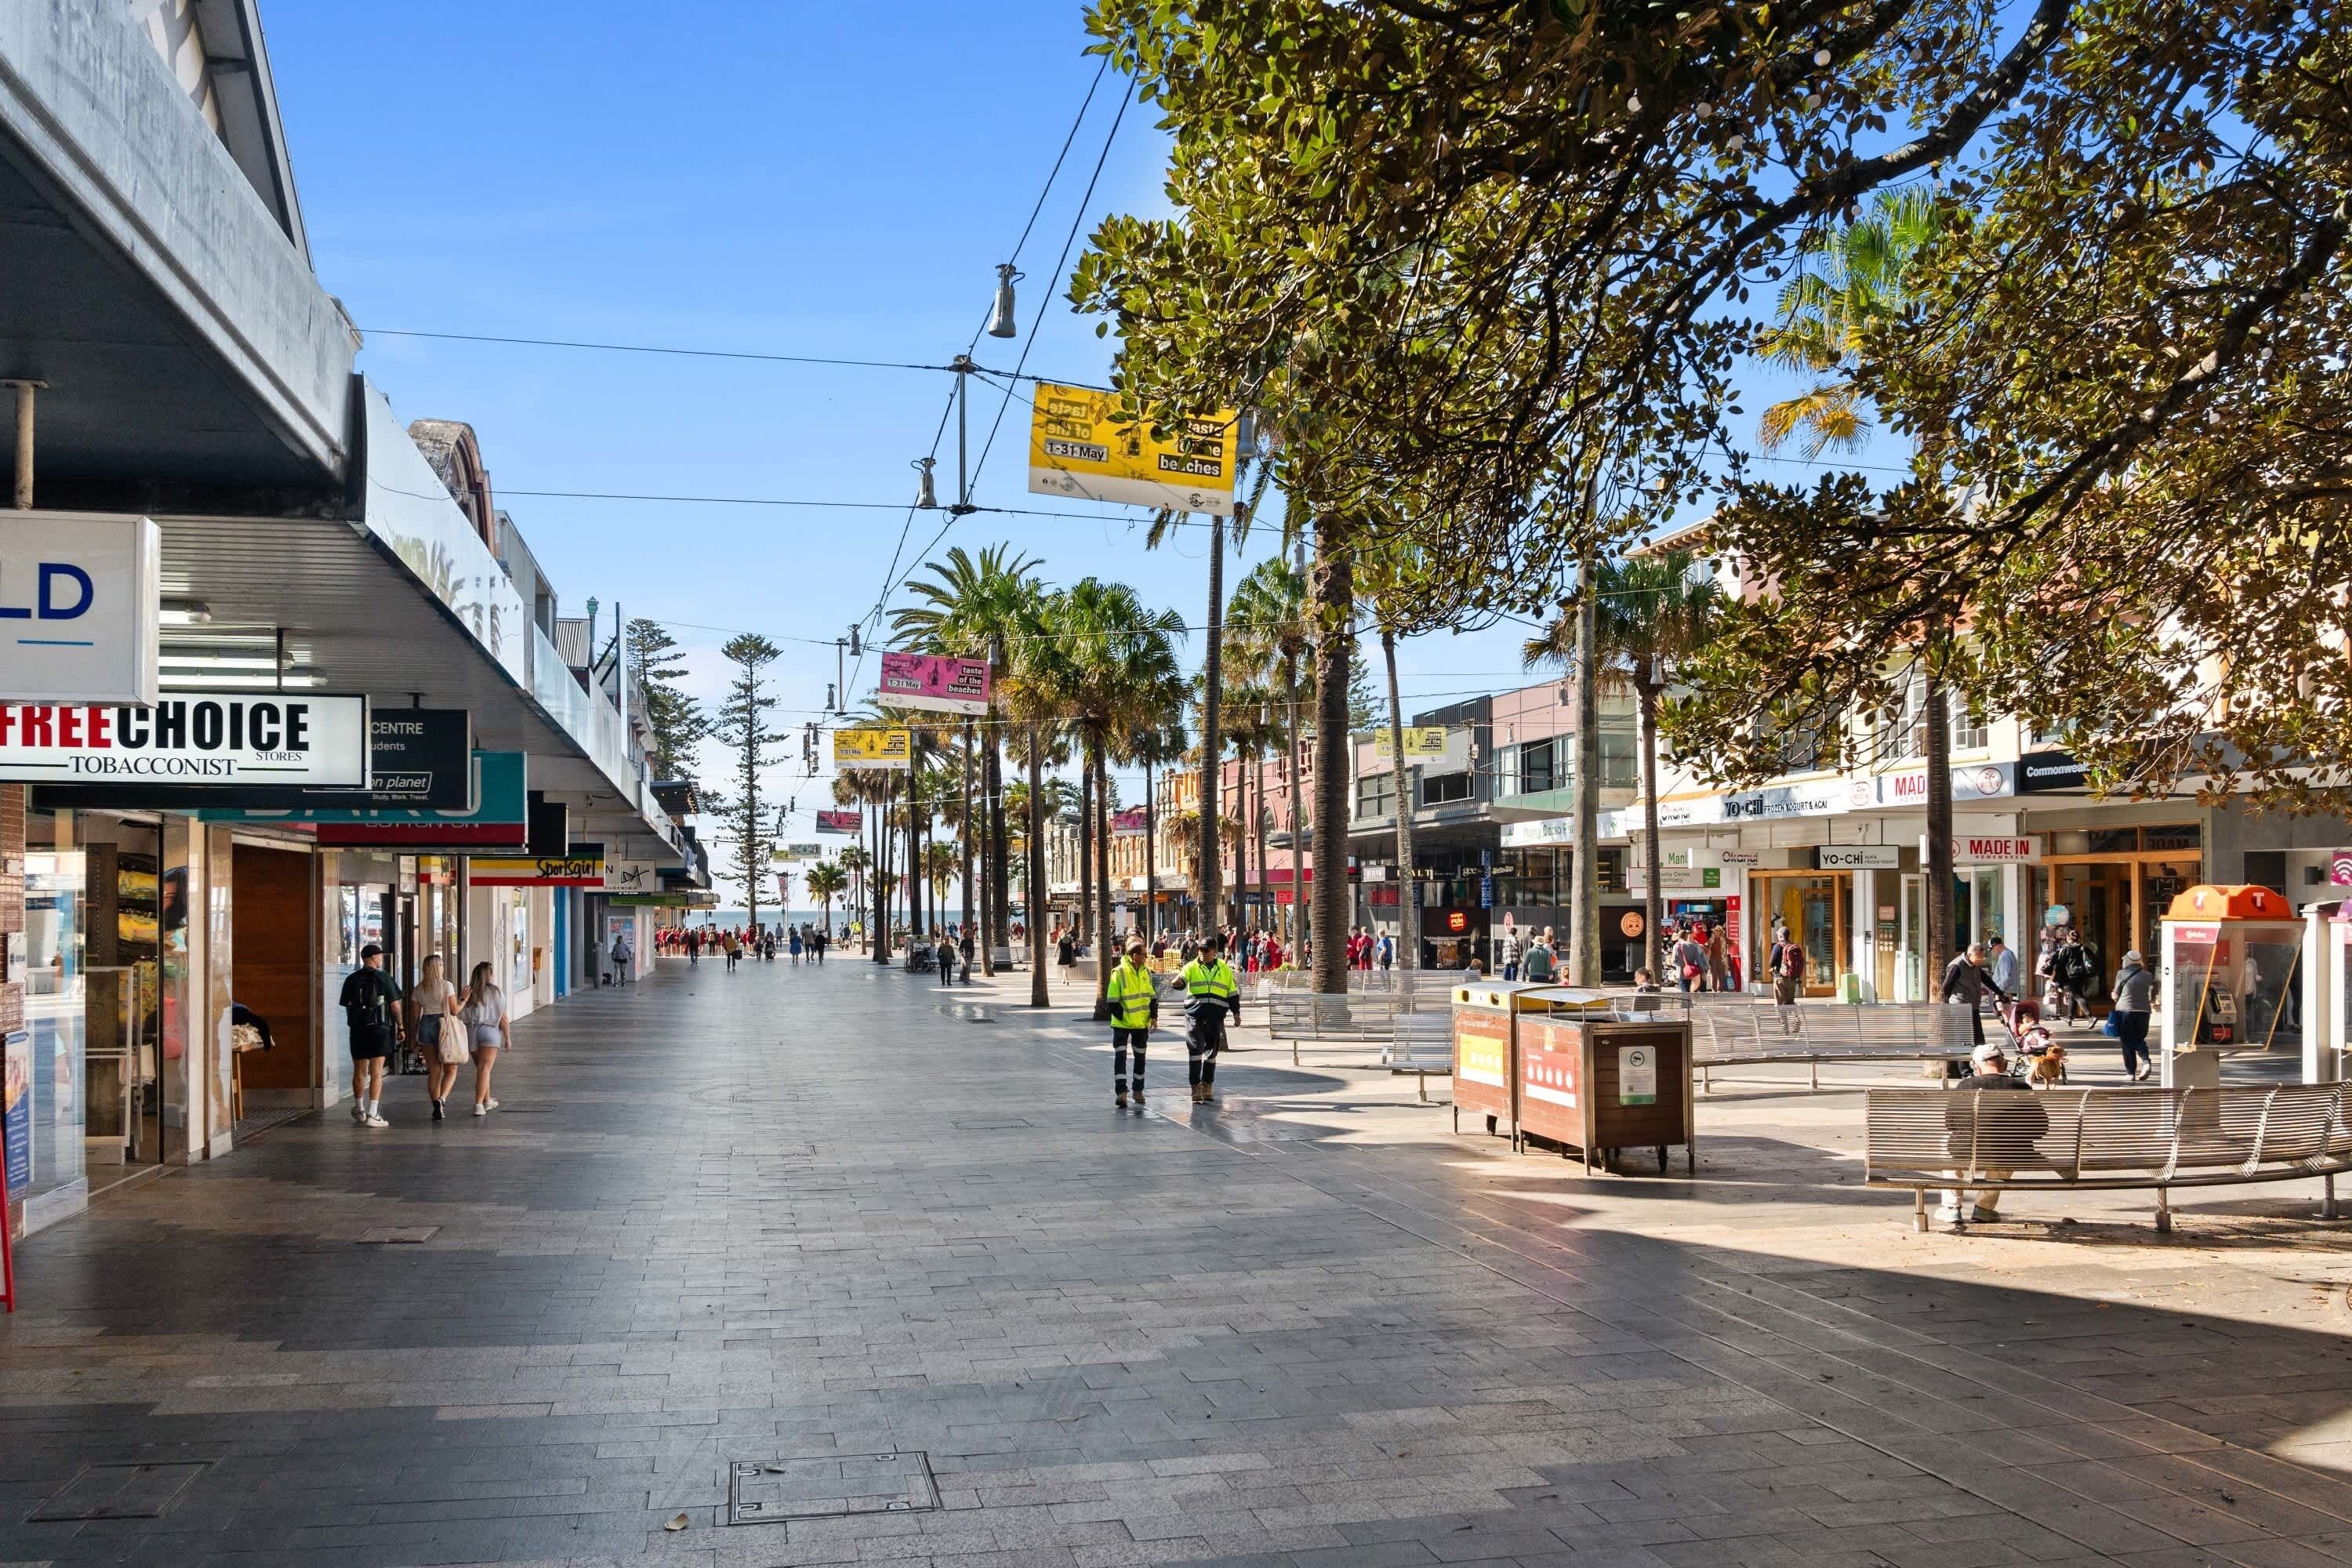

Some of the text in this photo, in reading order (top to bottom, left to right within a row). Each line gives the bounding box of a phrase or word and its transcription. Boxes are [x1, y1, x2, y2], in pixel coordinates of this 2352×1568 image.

[1047, 442, 1105, 462] 1-31 May
[1160, 456, 1220, 475] beches
[906, 681, 920, 690] May
[949, 684, 981, 695] beaches
[371, 722, 423, 735] CENTRE
[256, 752, 303, 762] STORES
[69, 756, 238, 776] TOBACCONIST
[386, 776, 426, 789] planet
[1764, 804, 1784, 815] FROZEN
[1786, 801, 1808, 812] YOGURT
[1969, 840, 2029, 855] MADE IN
[1722, 851, 1759, 863] Okanui
[536, 855, 596, 878] Sportsgirl
